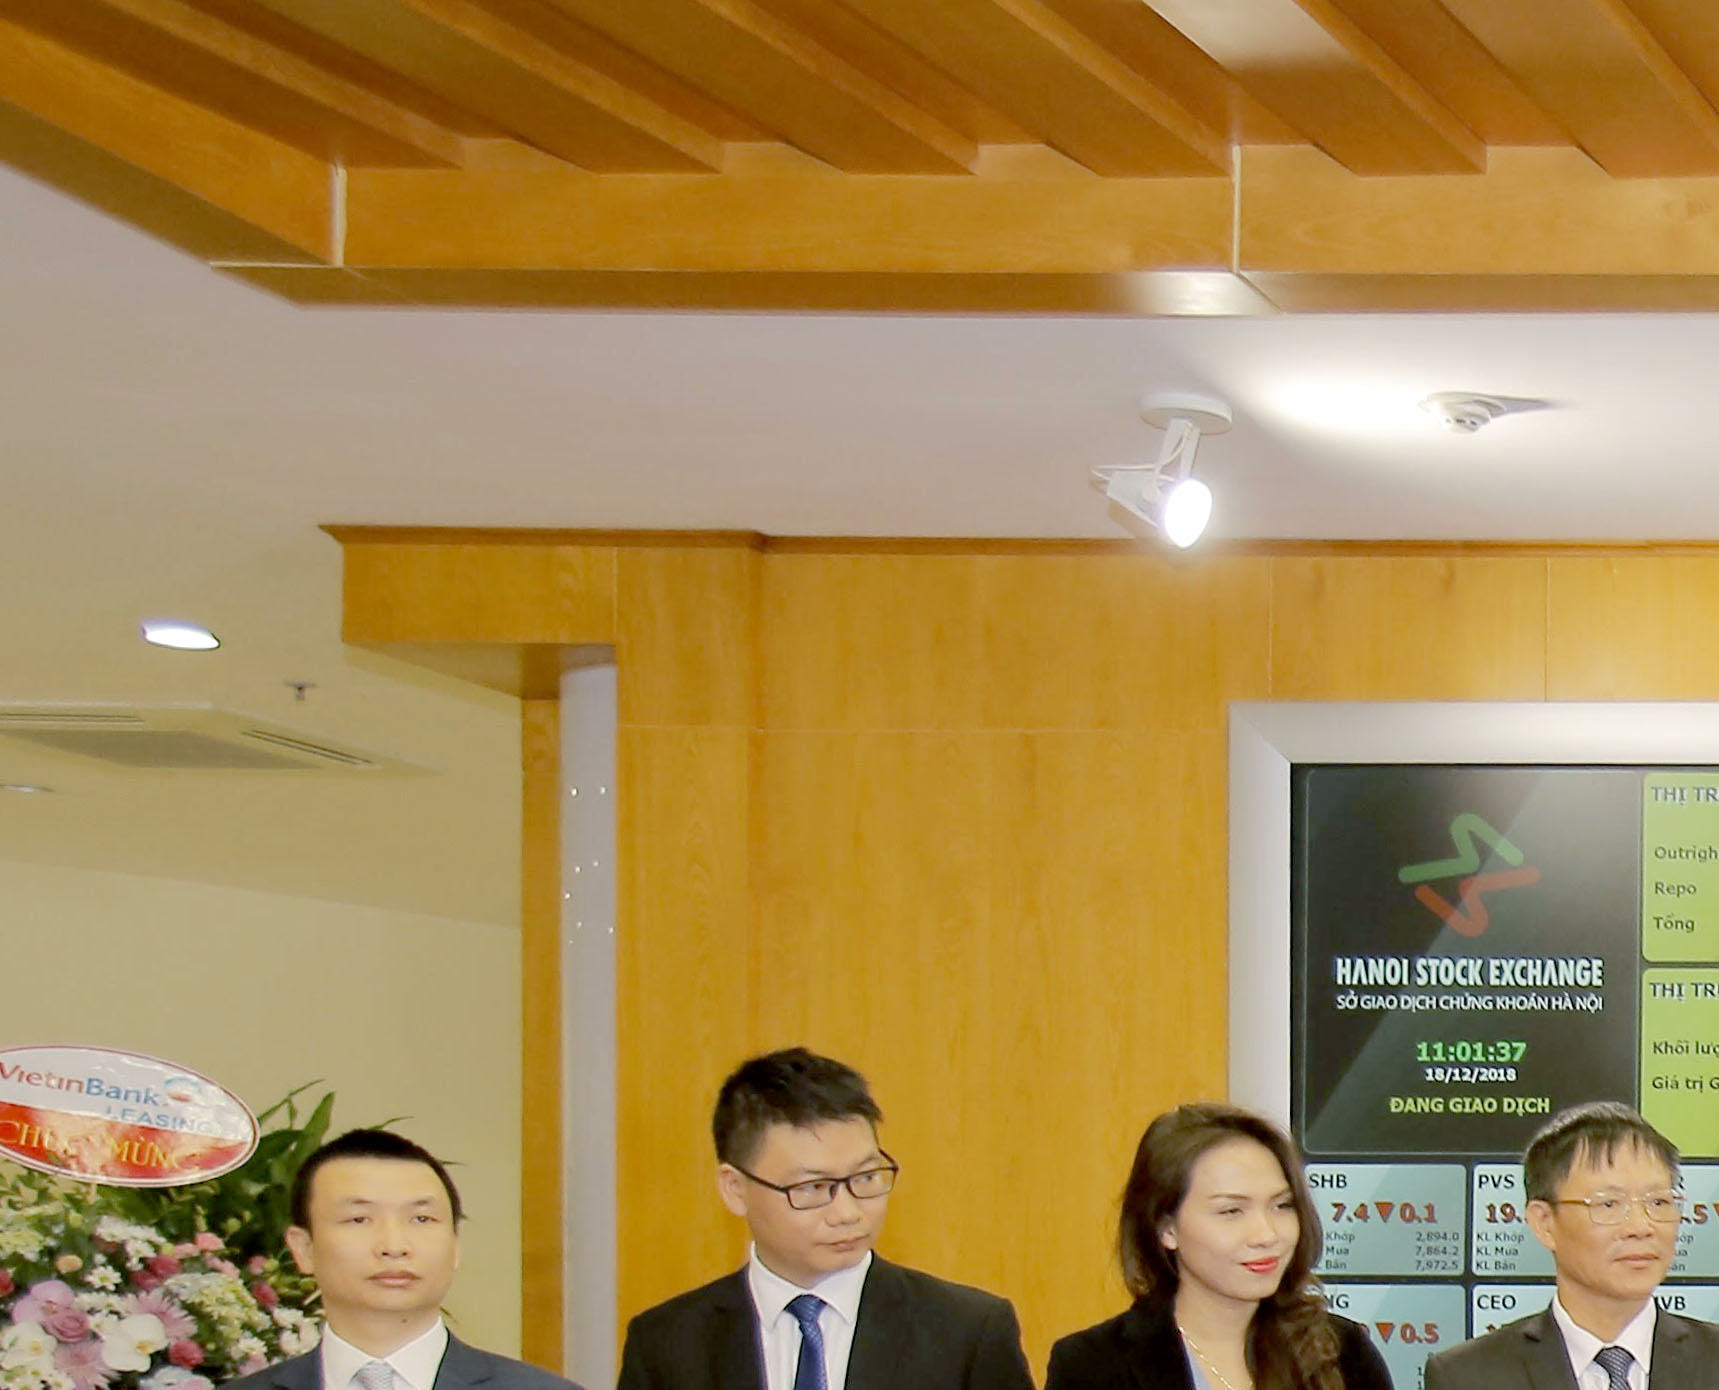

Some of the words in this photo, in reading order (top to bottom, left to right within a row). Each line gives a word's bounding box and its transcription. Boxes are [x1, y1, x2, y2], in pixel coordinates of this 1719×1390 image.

[1651, 786, 1687, 806] THỊ
[1654, 881, 1697, 899] Repo
[1653, 913, 1695, 933] Tổng
[1336, 958, 1409, 985] HANOI
[1416, 958, 1483, 986] STOCK
[1488, 958, 1604, 986] EXCHANGE
[1361, 995, 1398, 1009] GIAO
[1400, 995, 1436, 1012] DỊCH
[1496, 991, 1549, 1010] KHOÁN
[1551, 990, 1574, 1009] HÀ
[1576, 992, 1604, 1013] NỘI
[1650, 982, 1684, 1002] THỊ
[1416, 1041, 1527, 1062] 11:01:37
[1425, 1067, 1517, 1083] 18/12/2018
[1652, 1076, 1679, 1091] Giá
[1685, 1077, 1704, 1094] trị
[1389, 1096, 1444, 1113] ĐANG
[1449, 1096, 1497, 1113] GIAO
[1503, 1097, 1550, 1117] DỊCH
[1477, 1174, 1515, 1189] PVS
[1331, 1203, 1370, 1223] 7.4
[1399, 1203, 1438, 1224] 0.1
